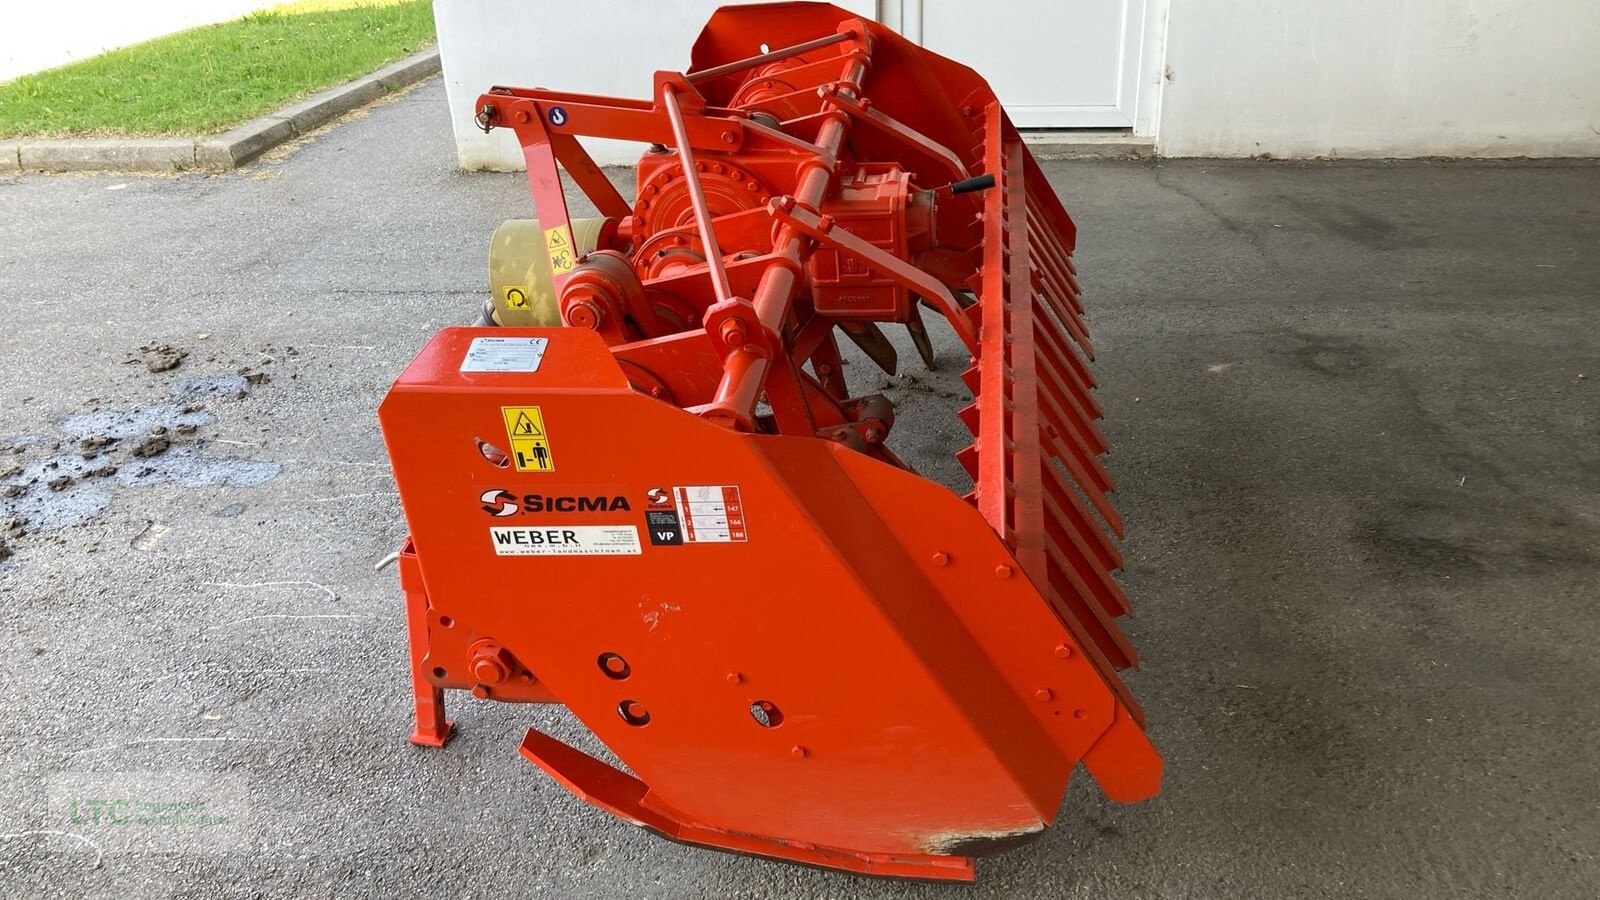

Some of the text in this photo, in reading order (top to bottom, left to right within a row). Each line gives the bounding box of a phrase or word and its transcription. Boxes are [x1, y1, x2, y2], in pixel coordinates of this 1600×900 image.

[523, 494, 631, 512] SICMA
[494, 530, 579, 545] WEBER
[657, 531, 675, 541] VP
